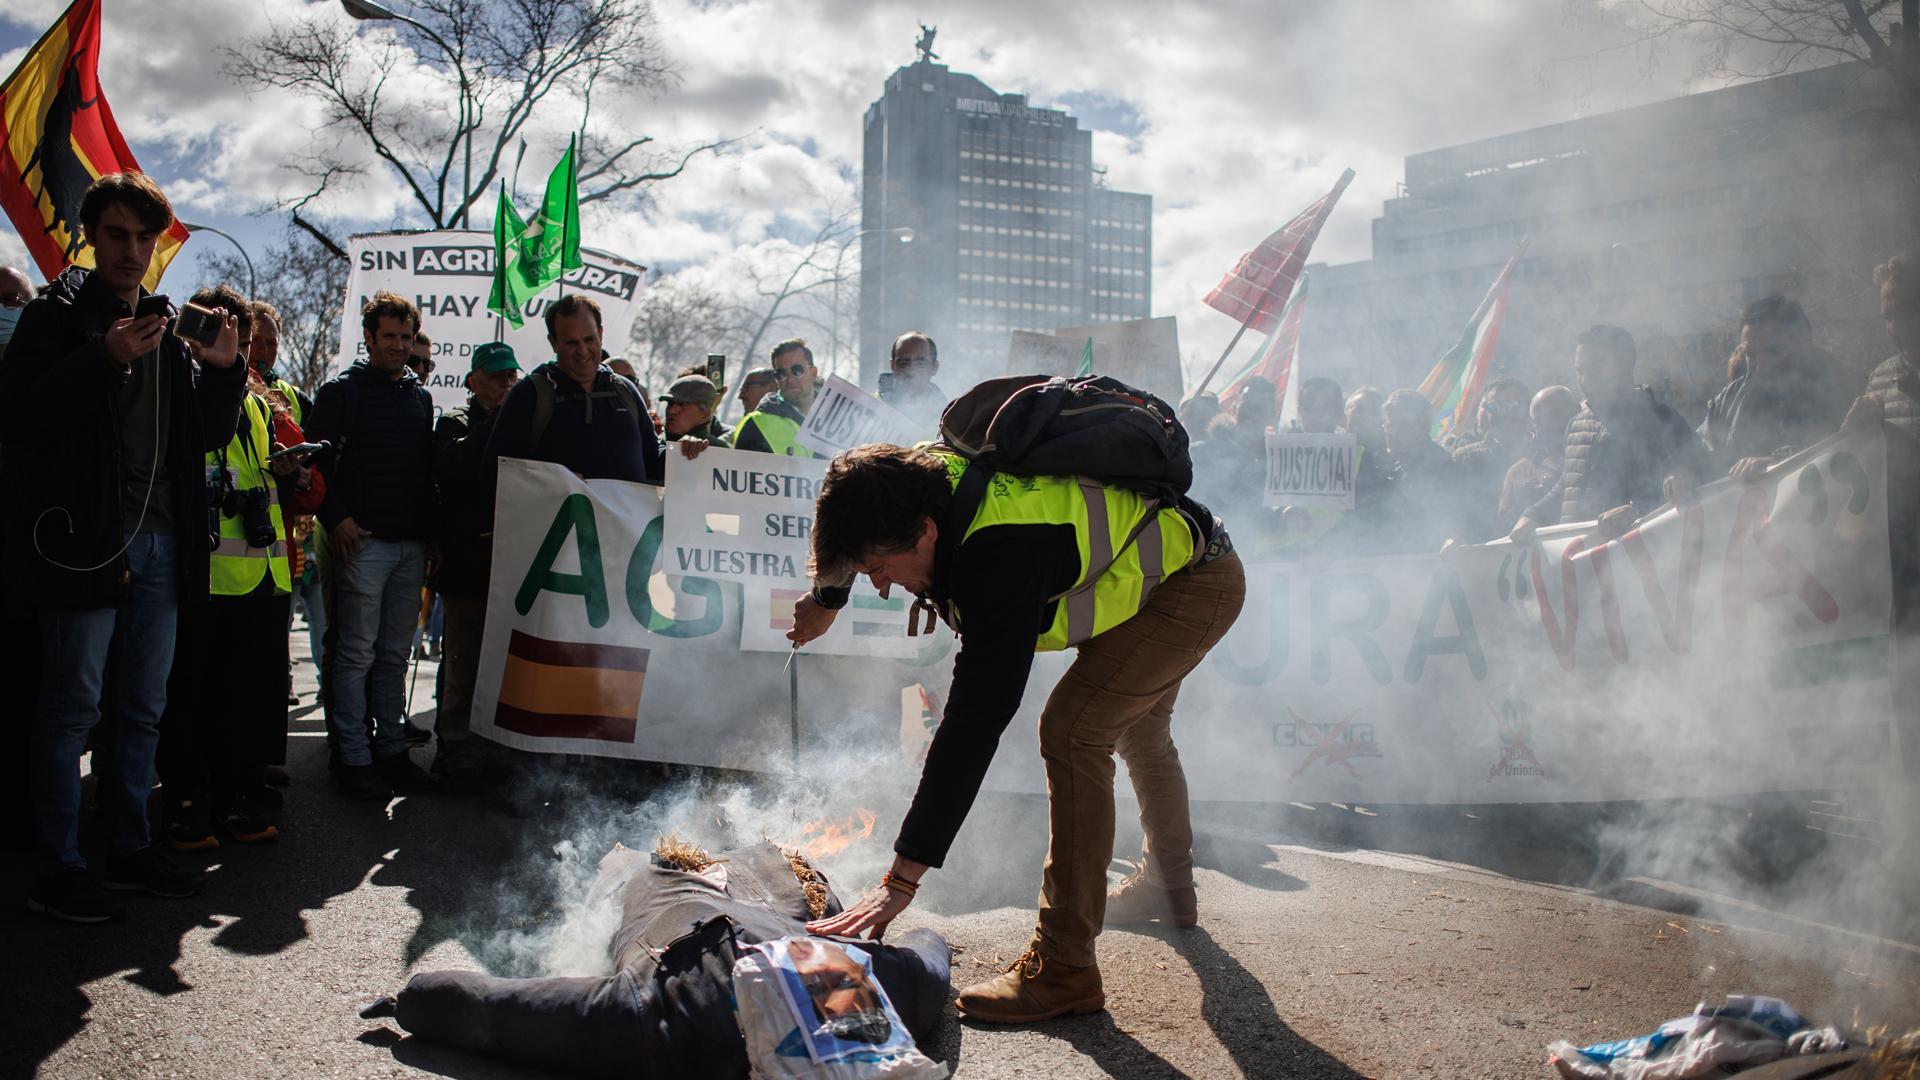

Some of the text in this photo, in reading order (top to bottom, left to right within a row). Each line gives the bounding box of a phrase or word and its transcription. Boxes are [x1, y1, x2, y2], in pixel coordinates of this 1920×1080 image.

[360, 250, 407, 271] SIN
[416, 294, 480, 318] HAY
[1268, 445, 1353, 492] ¡JUSTICIA!
[765, 513, 814, 539] SER
[676, 547, 797, 578] VUESTRA
